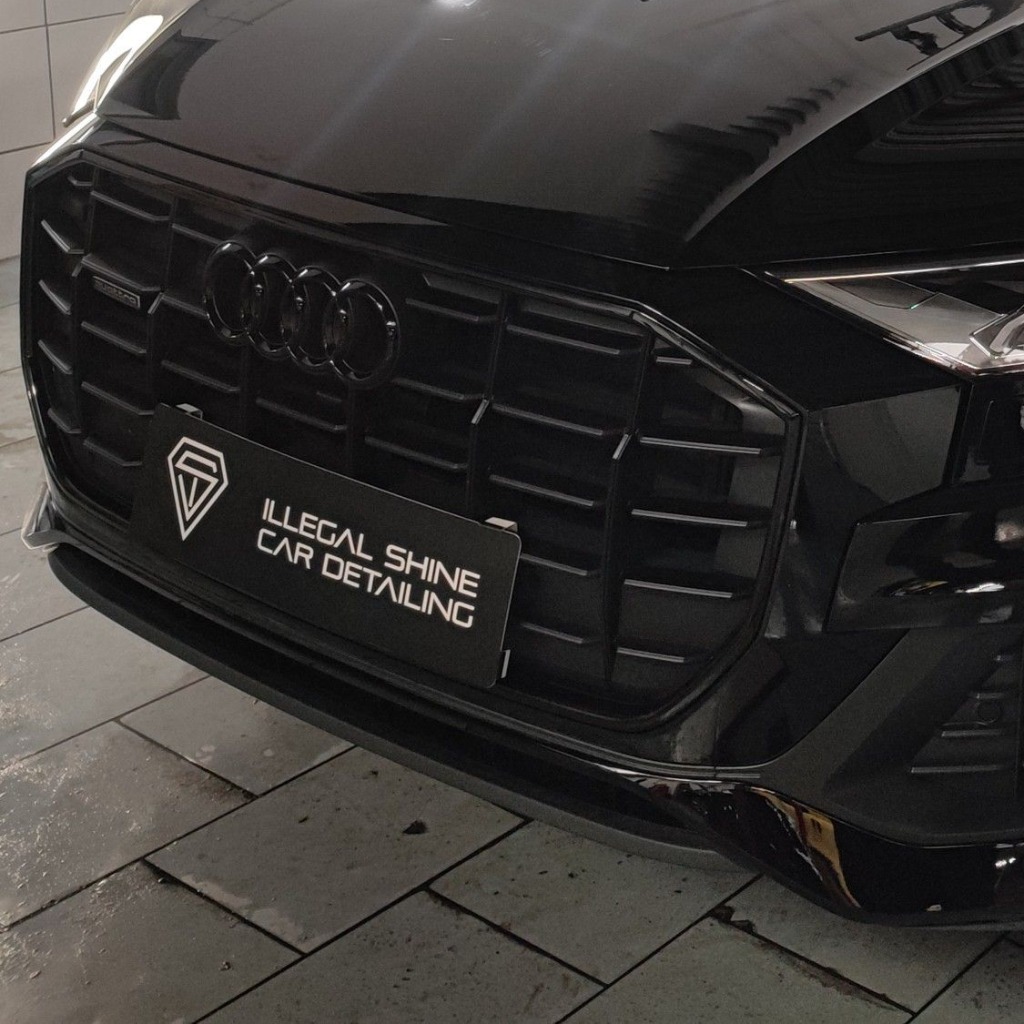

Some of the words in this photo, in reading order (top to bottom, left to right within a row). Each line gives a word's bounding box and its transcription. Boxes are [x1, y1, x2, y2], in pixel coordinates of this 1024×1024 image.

[257, 528, 313, 570] CAR
[321, 554, 475, 628] DETAILING
[261, 497, 373, 562] ILLEGAL
[384, 543, 481, 598] SHINE
